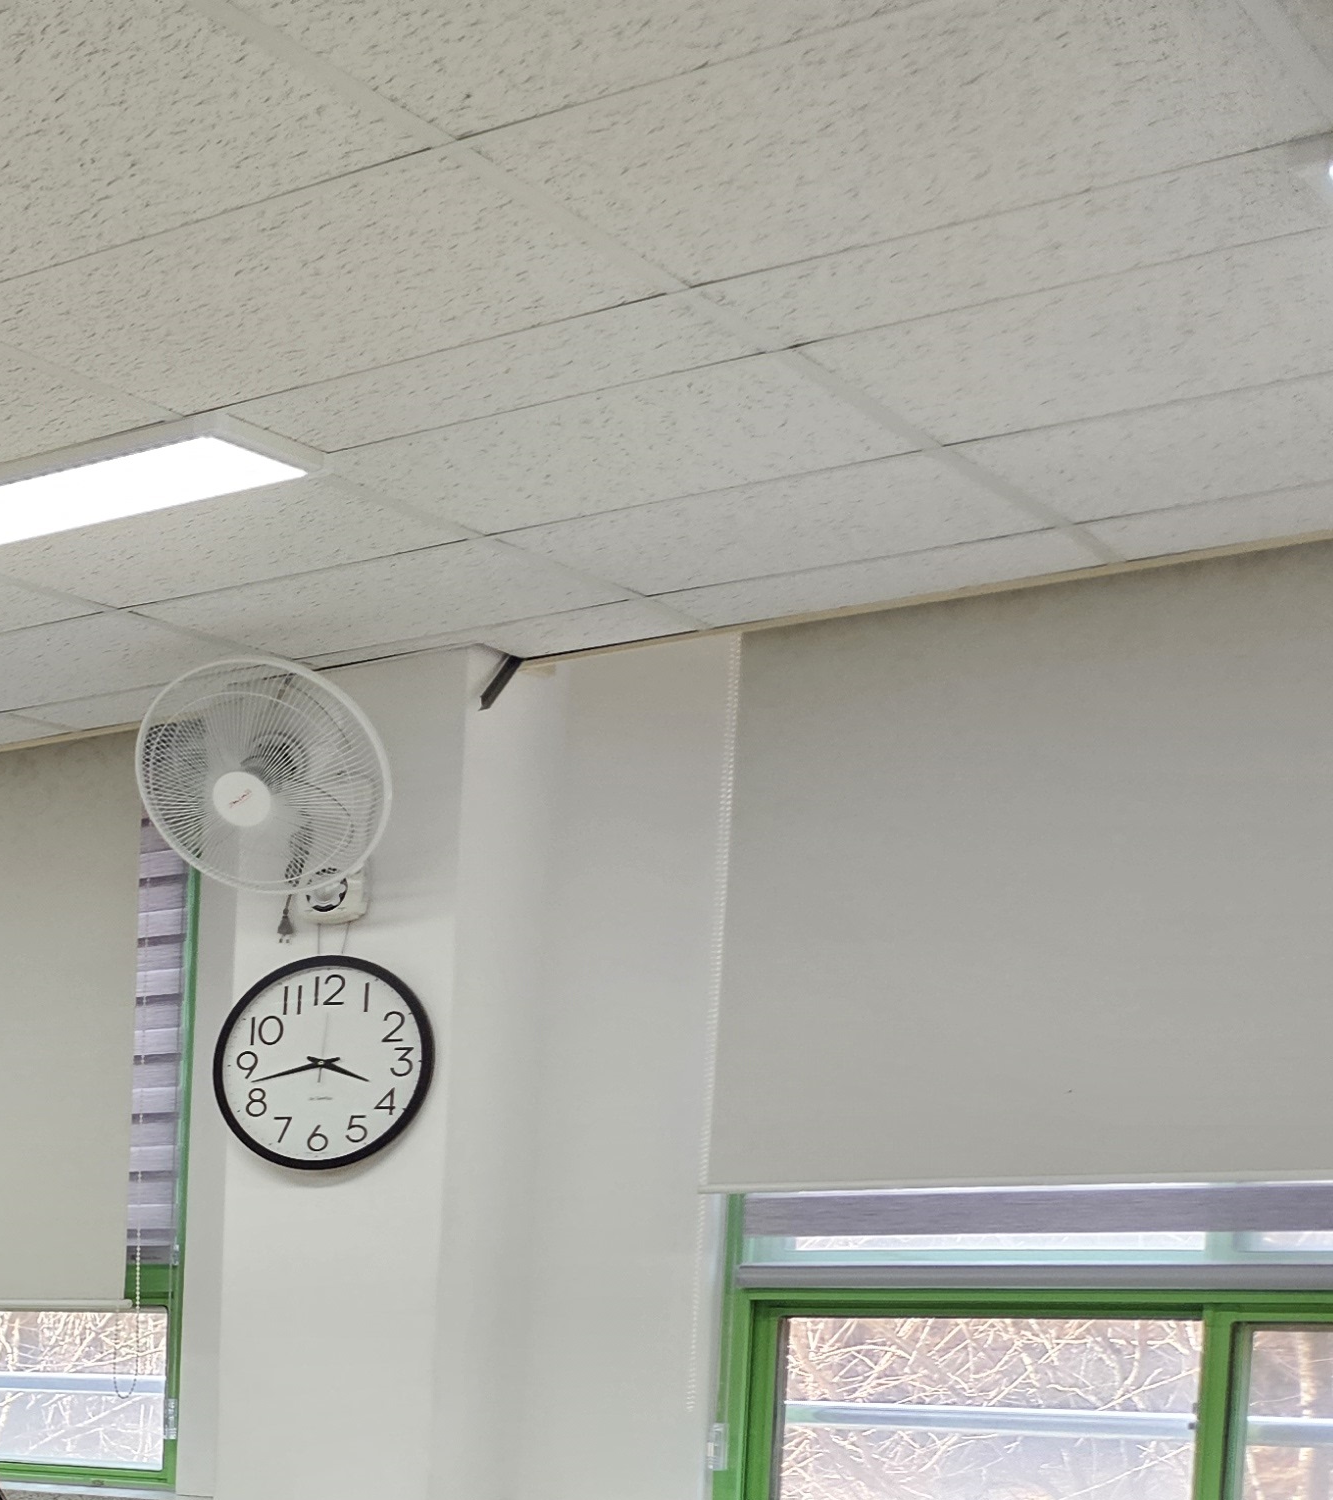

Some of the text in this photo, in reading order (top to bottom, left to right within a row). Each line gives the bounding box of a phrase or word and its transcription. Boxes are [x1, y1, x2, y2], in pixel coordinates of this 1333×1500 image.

[283, 984, 303, 1015] 11
[313, 974, 346, 1006] 12
[364, 982, 370, 1013] 1
[250, 1015, 284, 1046] 10
[381, 1011, 406, 1043] 2
[236, 1050, 259, 1080] 9
[390, 1046, 415, 1077] 3
[245, 1087, 267, 1118] 8
[373, 1087, 396, 1116] 4
[273, 1116, 293, 1144] 7
[307, 1124, 329, 1152] 6
[345, 1114, 368, 1143] 5
